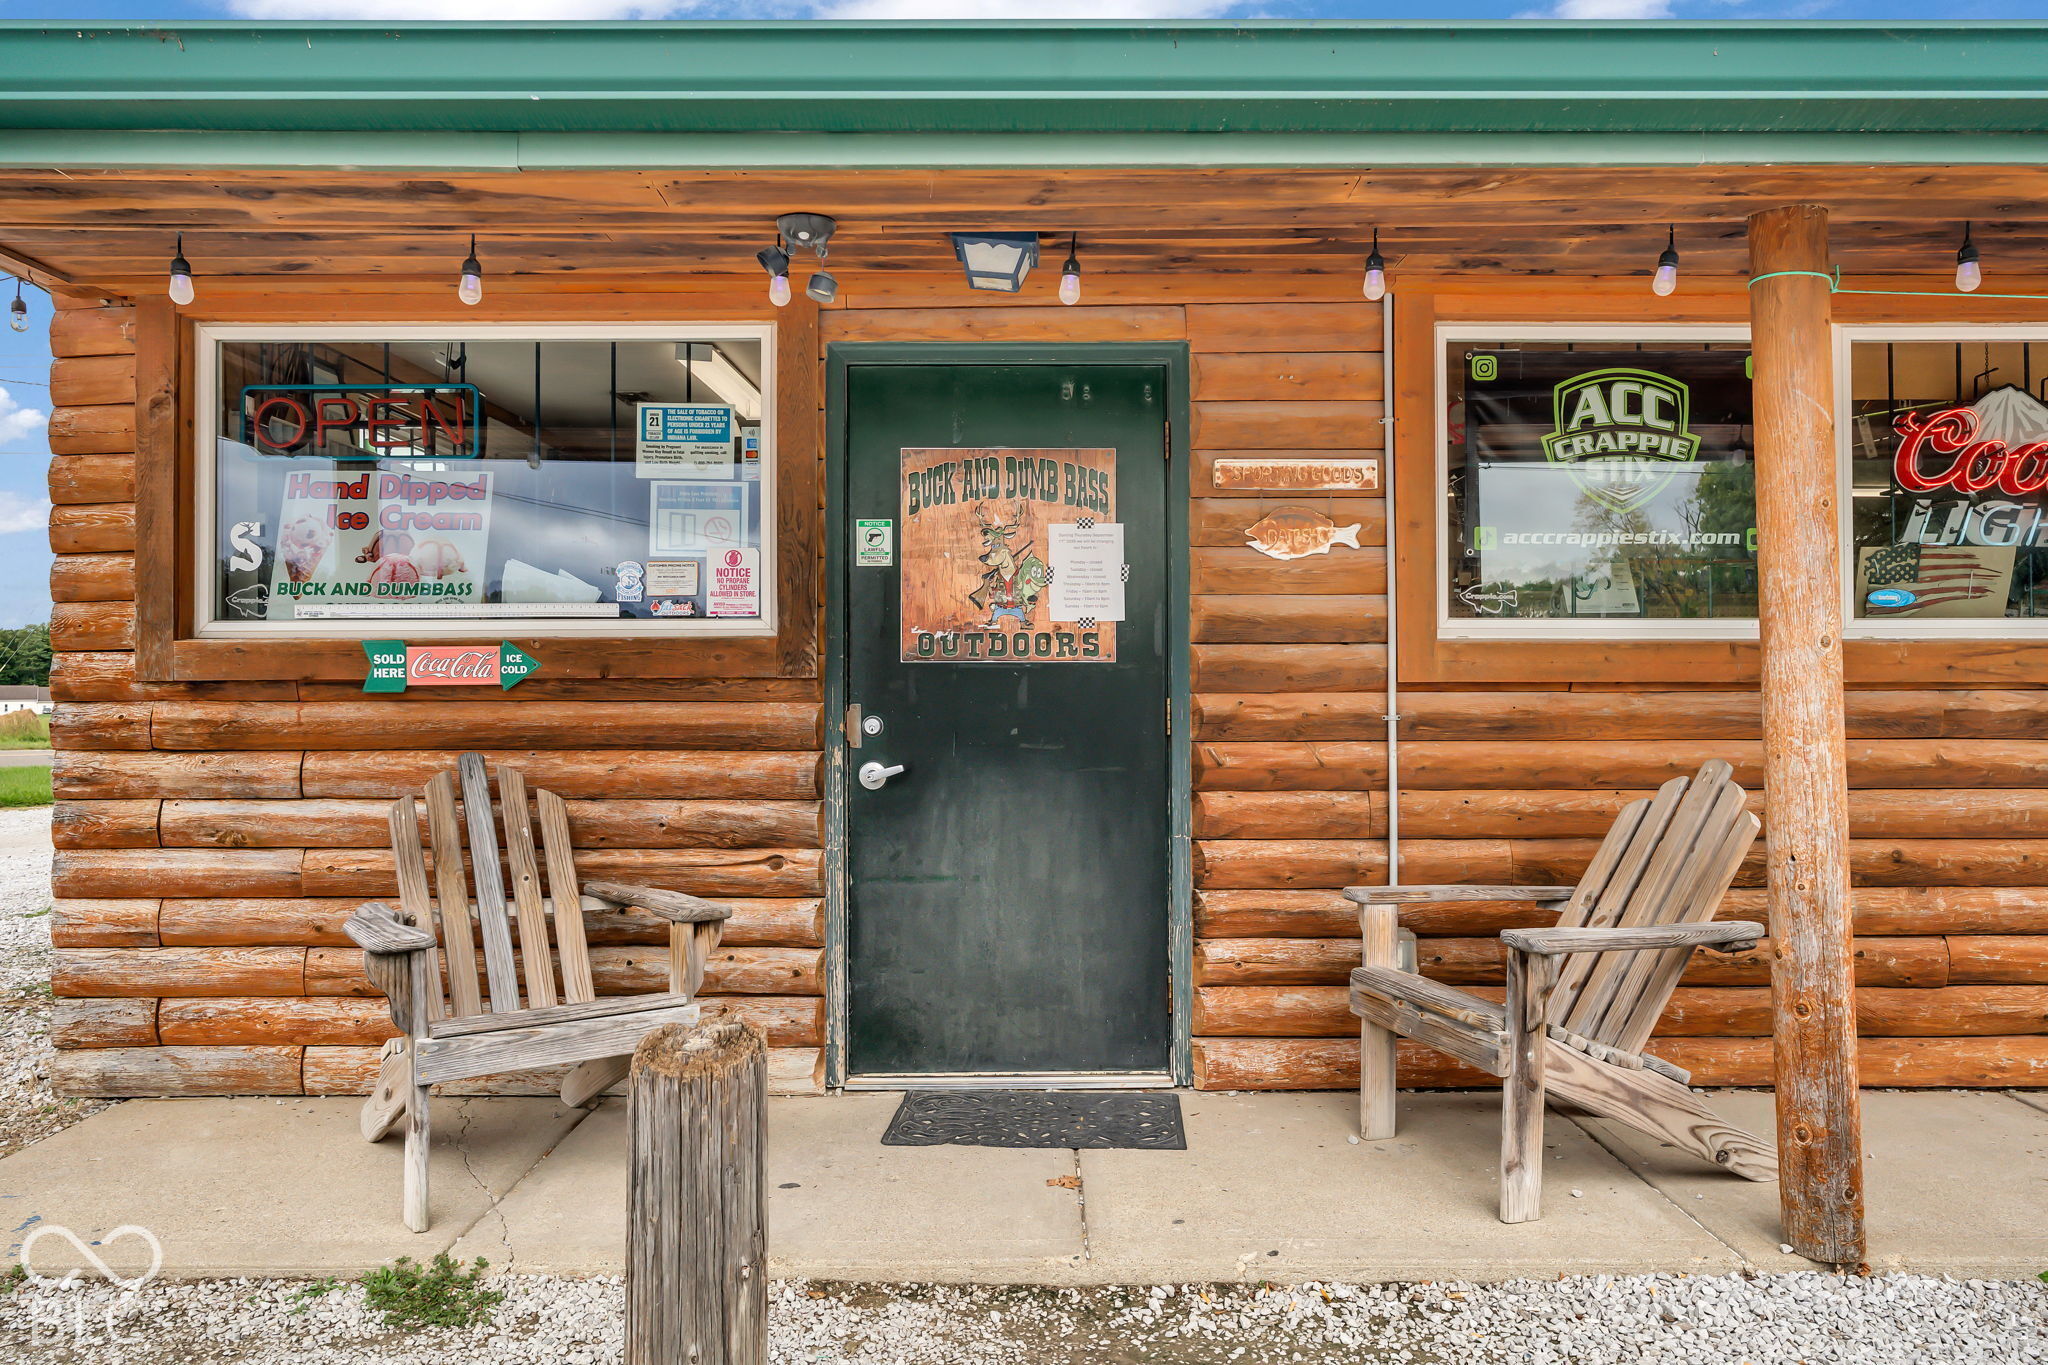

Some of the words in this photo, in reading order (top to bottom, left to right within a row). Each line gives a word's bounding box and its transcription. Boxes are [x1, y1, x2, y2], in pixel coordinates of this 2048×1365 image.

[1567, 381, 1675, 432] ACC
[253, 397, 465, 449] OPEN
[649, 417, 660, 427] 21
[1553, 430, 1691, 461] CRAPPIE
[1311, 466, 1363, 481] GOODS
[1586, 456, 1659, 482] STIX
[288, 473, 370, 499] Hand
[379, 473, 488, 505] Dipped
[908, 462, 956, 516] BUCK
[962, 456, 1000, 502] AND
[1005, 456, 1059, 503] DUMB
[1064, 461, 1110, 516] BASS
[326, 504, 370, 530] Ice
[379, 504, 483, 531] Cream
[1503, 530, 1740, 548] acccrappiestix.com
[716, 567, 751, 577] NOTICE
[277, 582, 326, 596] BUCK
[331, 582, 372, 596] AND
[377, 582, 473, 596] DUMBBASS
[917, 632, 1100, 657] OUTDOORS
[374, 654, 405, 665] SOLD
[411, 651, 498, 679] Coca-Cola
[506, 654, 523, 663] ICE
[374, 668, 405, 678] HERE
[501, 665, 528, 675] COLD
